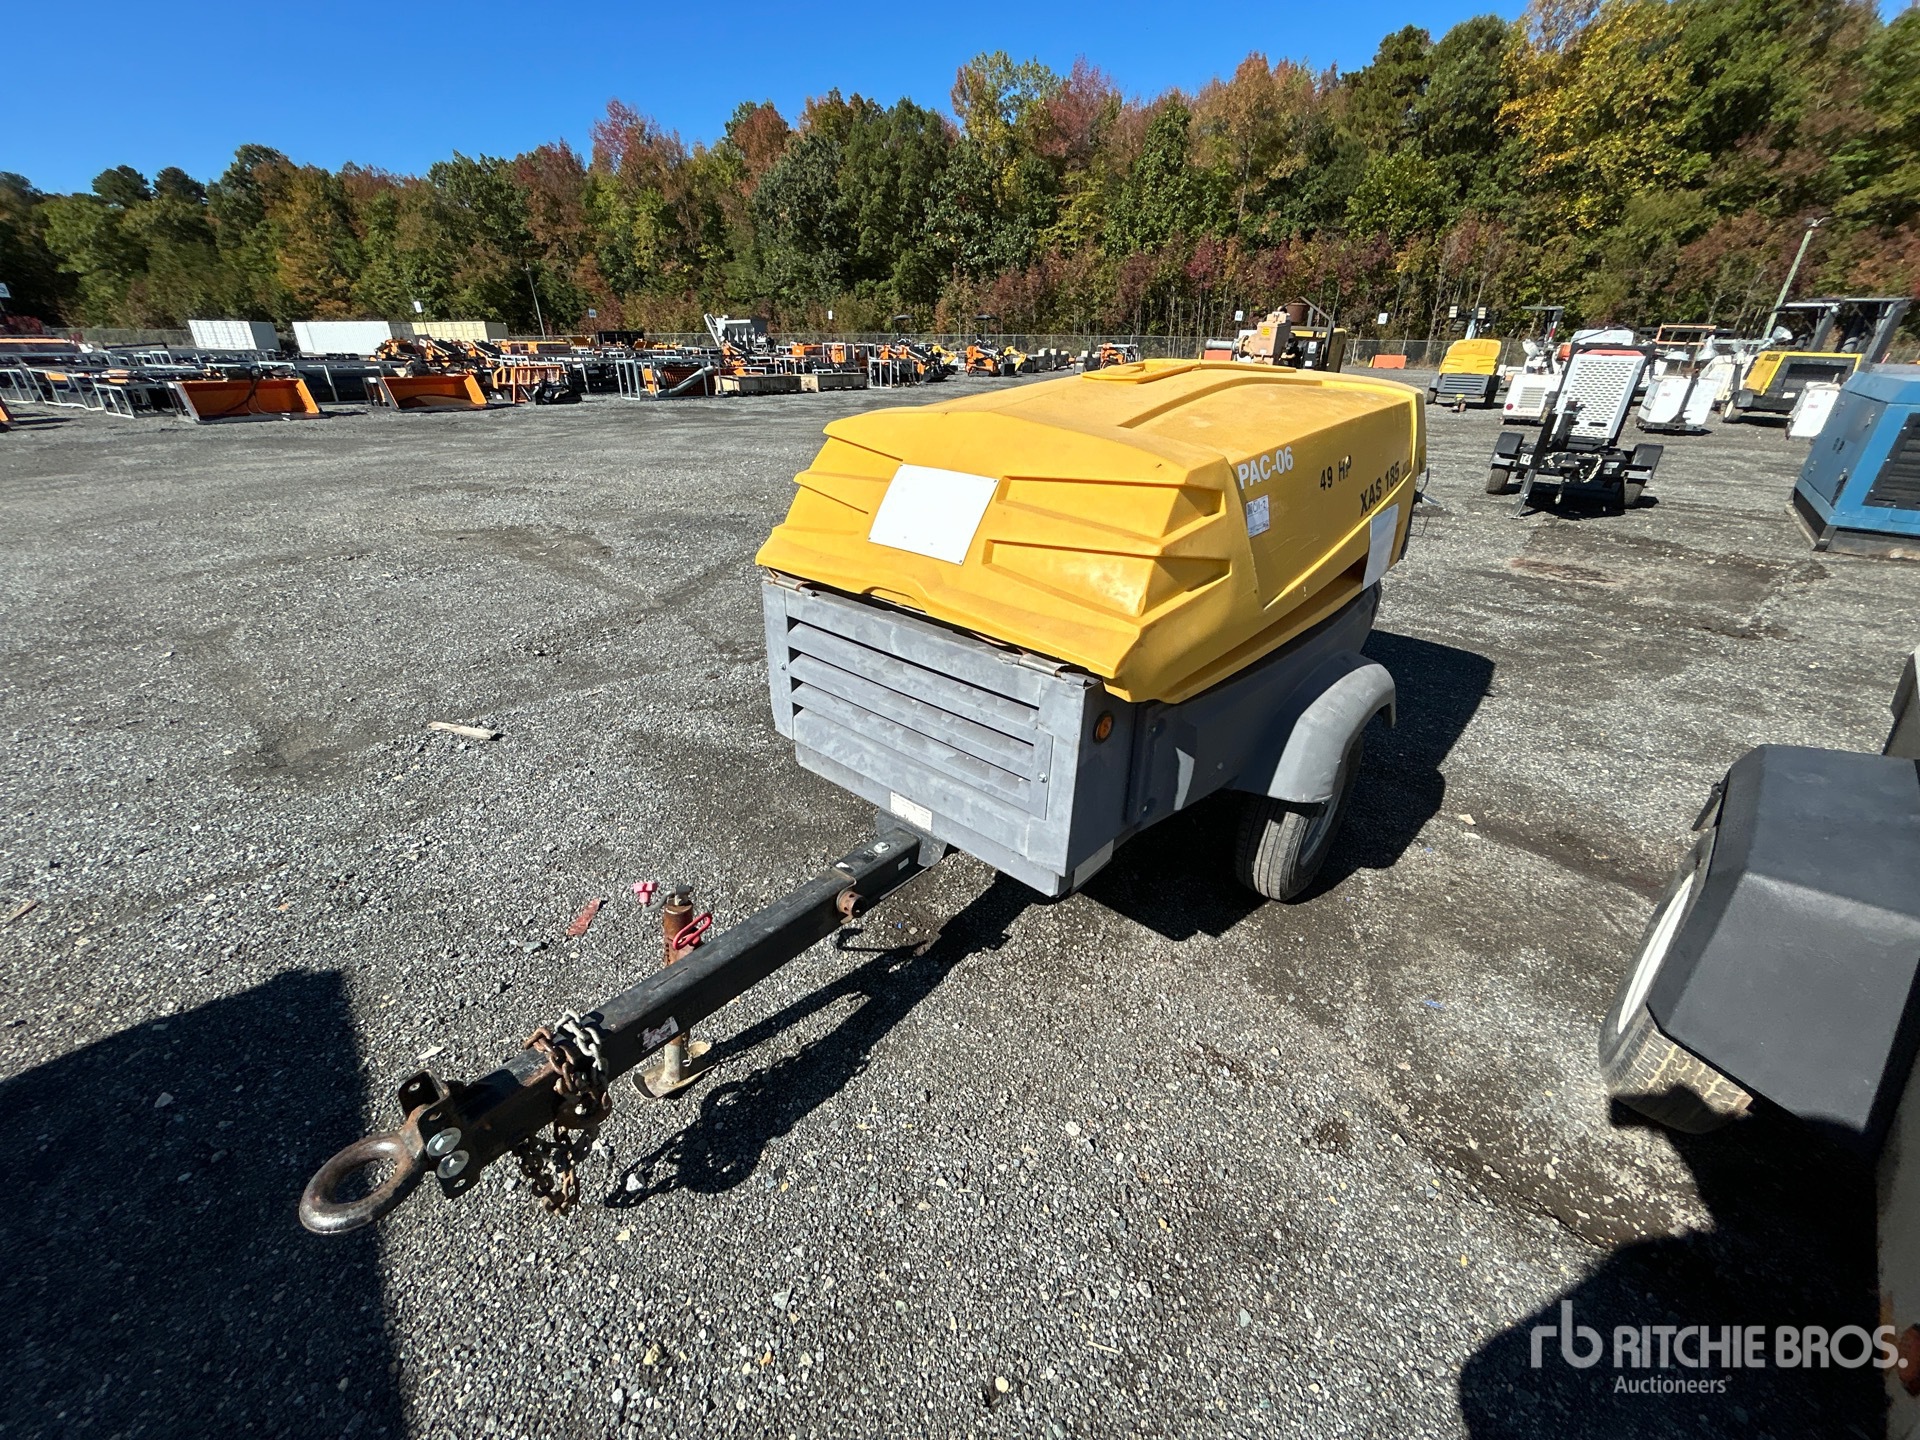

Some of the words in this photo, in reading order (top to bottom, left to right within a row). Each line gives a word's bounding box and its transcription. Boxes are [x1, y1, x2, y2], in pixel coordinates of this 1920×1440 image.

[1237, 446, 1294, 490] PAC-06
[1320, 467, 1333, 491] 49
[1338, 455, 1352, 482] HP
[1360, 478, 1382, 516] XAS
[1385, 464, 1400, 492] 185
